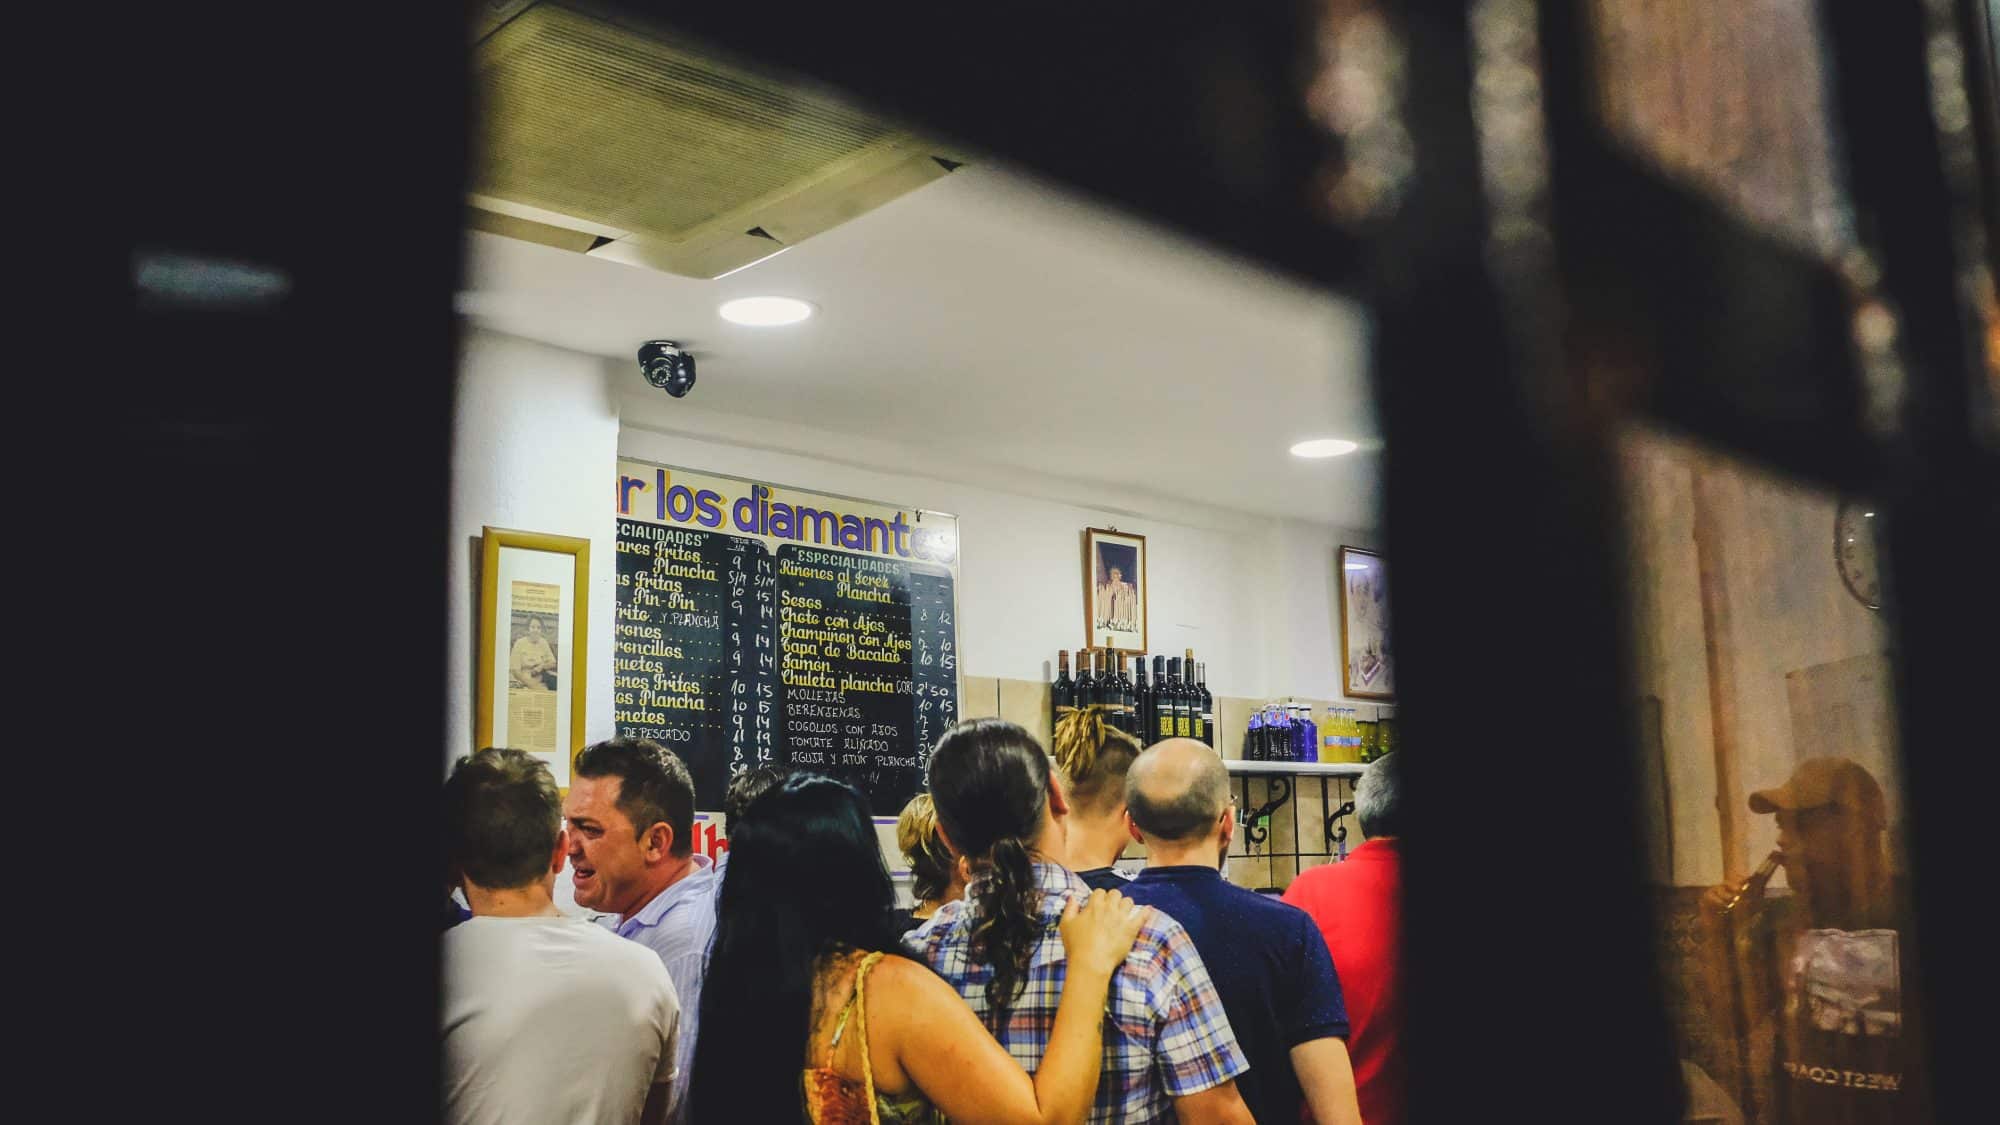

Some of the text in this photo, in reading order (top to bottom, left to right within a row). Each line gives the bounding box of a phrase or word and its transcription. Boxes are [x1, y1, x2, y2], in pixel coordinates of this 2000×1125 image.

[616, 475, 648, 515] r
[657, 469, 724, 528] los
[654, 541, 701, 563] Fritos
[653, 557, 718, 581] Plancha
[732, 555, 771, 573] 9 14
[779, 559, 834, 581] Riñones
[838, 567, 850, 583] al
[634, 571, 683, 593] Fritas
[633, 587, 697, 612] Pin-Pin
[732, 586, 771, 602] 10 15
[781, 590, 822, 609] Sesos
[836, 582, 892, 603] Plancha
[731, 601, 773, 618] 9 14
[920, 608, 951, 625] 8 12
[672, 612, 720, 629] PLANCHA
[780, 606, 886, 635] Choto con Ajos
[732, 632, 770, 648] 9 14
[859, 634, 880, 647] con
[884, 633, 912, 653] Ajos
[940, 638, 952, 652] 10
[781, 637, 901, 663] Tapa de Bacalao
[732, 650, 773, 669] 9 14
[782, 652, 832, 673] Jamón
[920, 650, 956, 669] 10 15
[654, 673, 700, 694] Fritos
[731, 679, 773, 698] 10 15
[781, 669, 836, 689] Chuleta
[841, 673, 894, 695] plancha
[615, 689, 705, 711] os Plancha
[787, 688, 847, 704] MOLLEJAS
[732, 698, 772, 714] 10 15
[787, 703, 861, 719] BERENJENAS
[918, 698, 953, 713] 10 15
[732, 714, 770, 729] 9 14
[788, 720, 898, 737] COGOLLOS CON AJOS
[920, 713, 928, 730] 7
[623, 727, 691, 742] DE PESCADO
[733, 729, 771, 745] 11 19
[789, 736, 889, 752] TOMATE ALIÑADO
[734, 746, 773, 762] 8 12
[791, 751, 825, 763] AGUJA
[875, 755, 916, 768] PLANCHA
